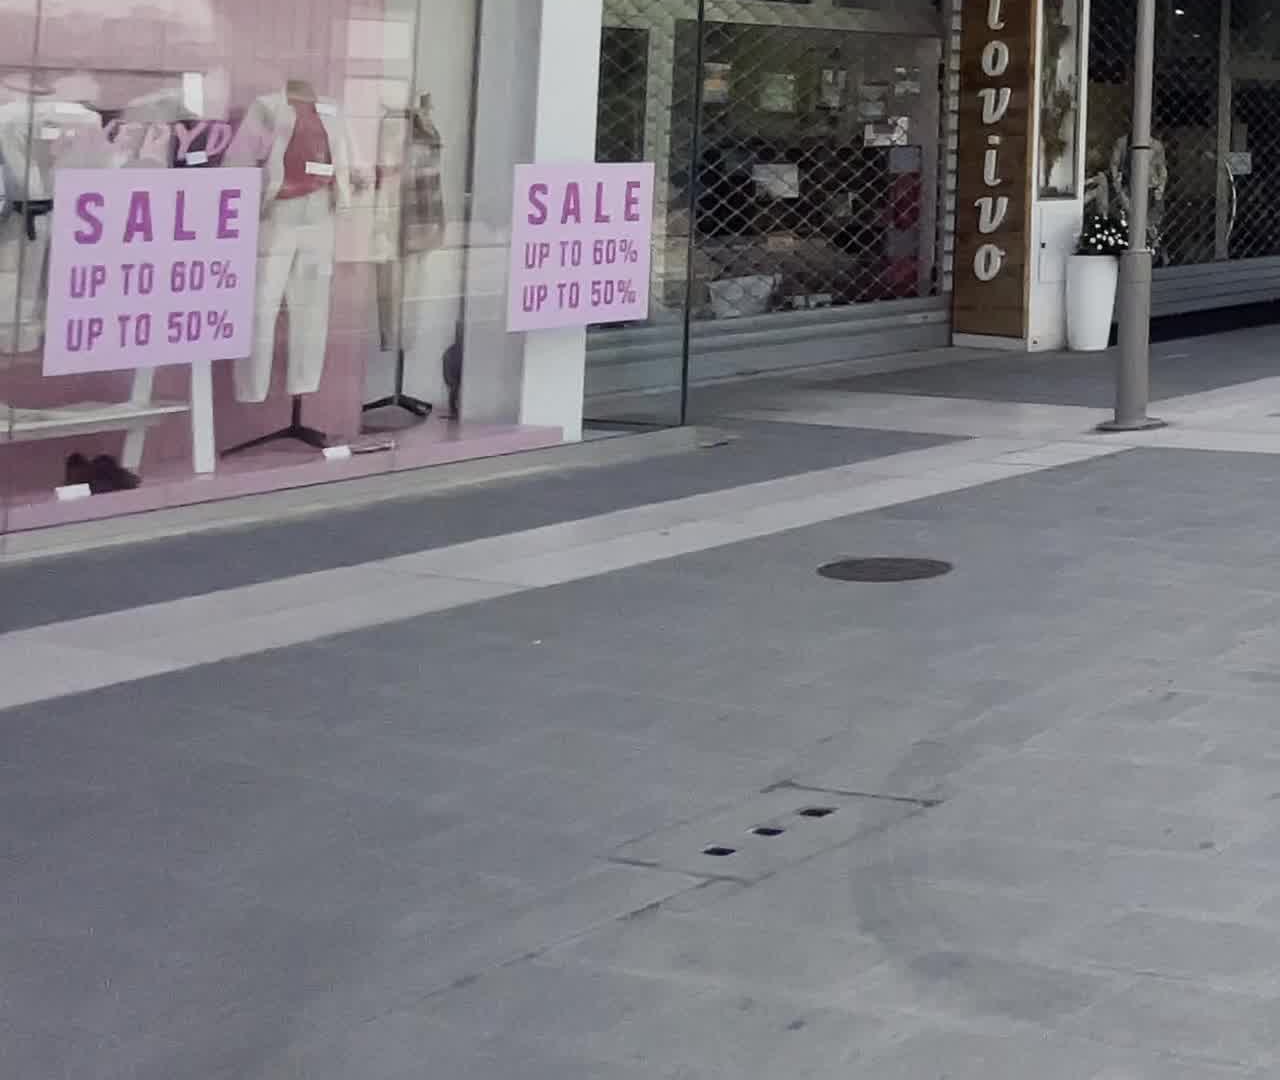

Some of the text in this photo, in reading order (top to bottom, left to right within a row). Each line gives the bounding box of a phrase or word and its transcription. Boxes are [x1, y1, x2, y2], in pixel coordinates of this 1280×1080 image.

[74, 188, 241, 245] SALE
[527, 180, 641, 226] SALE
[524, 238, 638, 270] UP TO 60%
[69, 259, 237, 299] UP TO 60%
[522, 279, 636, 313] UP TO 50%
[66, 308, 234, 352] UP TO 50%
